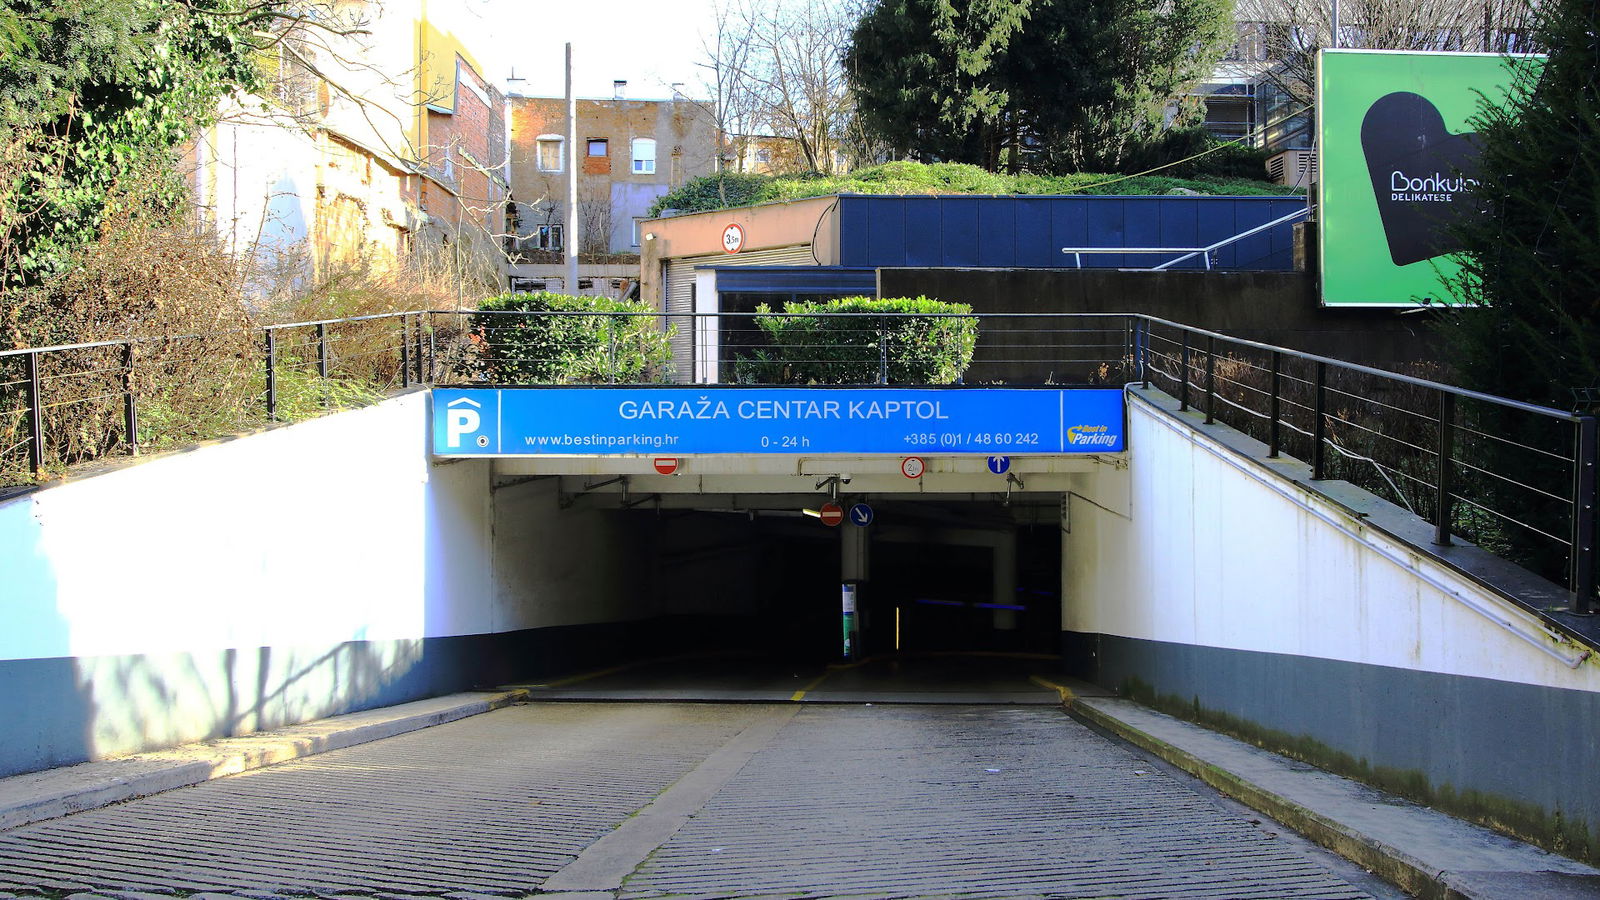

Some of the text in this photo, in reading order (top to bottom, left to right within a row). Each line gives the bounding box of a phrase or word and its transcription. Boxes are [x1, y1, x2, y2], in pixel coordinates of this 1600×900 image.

[1391, 193, 1452, 202] DELIKATESE
[618, 396, 949, 420] GARAŽA CENTAR KAPTOL
[524, 433, 679, 448] www.bestinparking.hr
[761, 436, 769, 447] 0
[781, 436, 798, 447] 24
[802, 436, 810, 447] h
[903, 433, 937, 445] +385
[940, 433, 962, 447] (0)1
[974, 433, 992, 445] 48
[994, 433, 1012, 445] 60
[1015, 433, 1039, 445] 242
[1072, 433, 1117, 446] Parking
